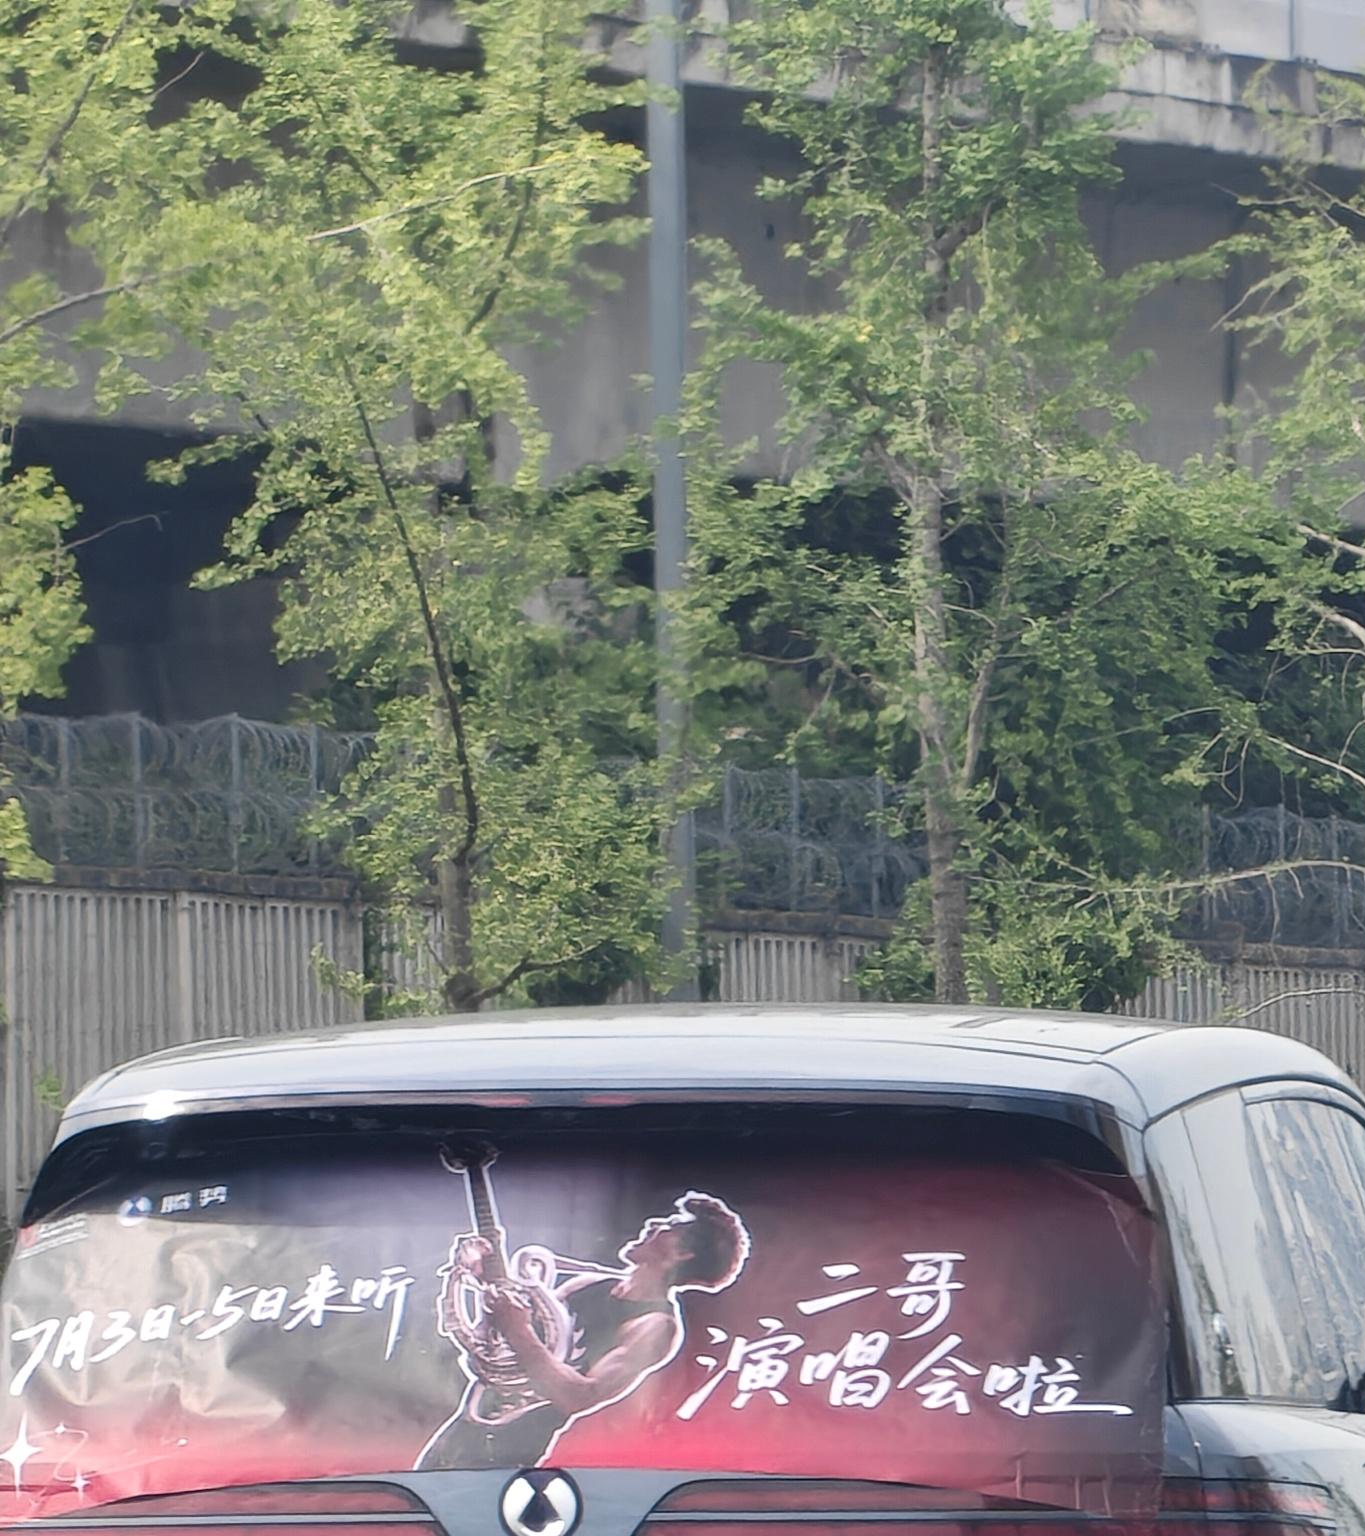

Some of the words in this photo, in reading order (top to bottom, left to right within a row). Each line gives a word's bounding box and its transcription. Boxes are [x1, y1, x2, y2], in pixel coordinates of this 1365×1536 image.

[797, 1252, 966, 1340] 二哥
[676, 1318, 1134, 1421] 演唱会啦
